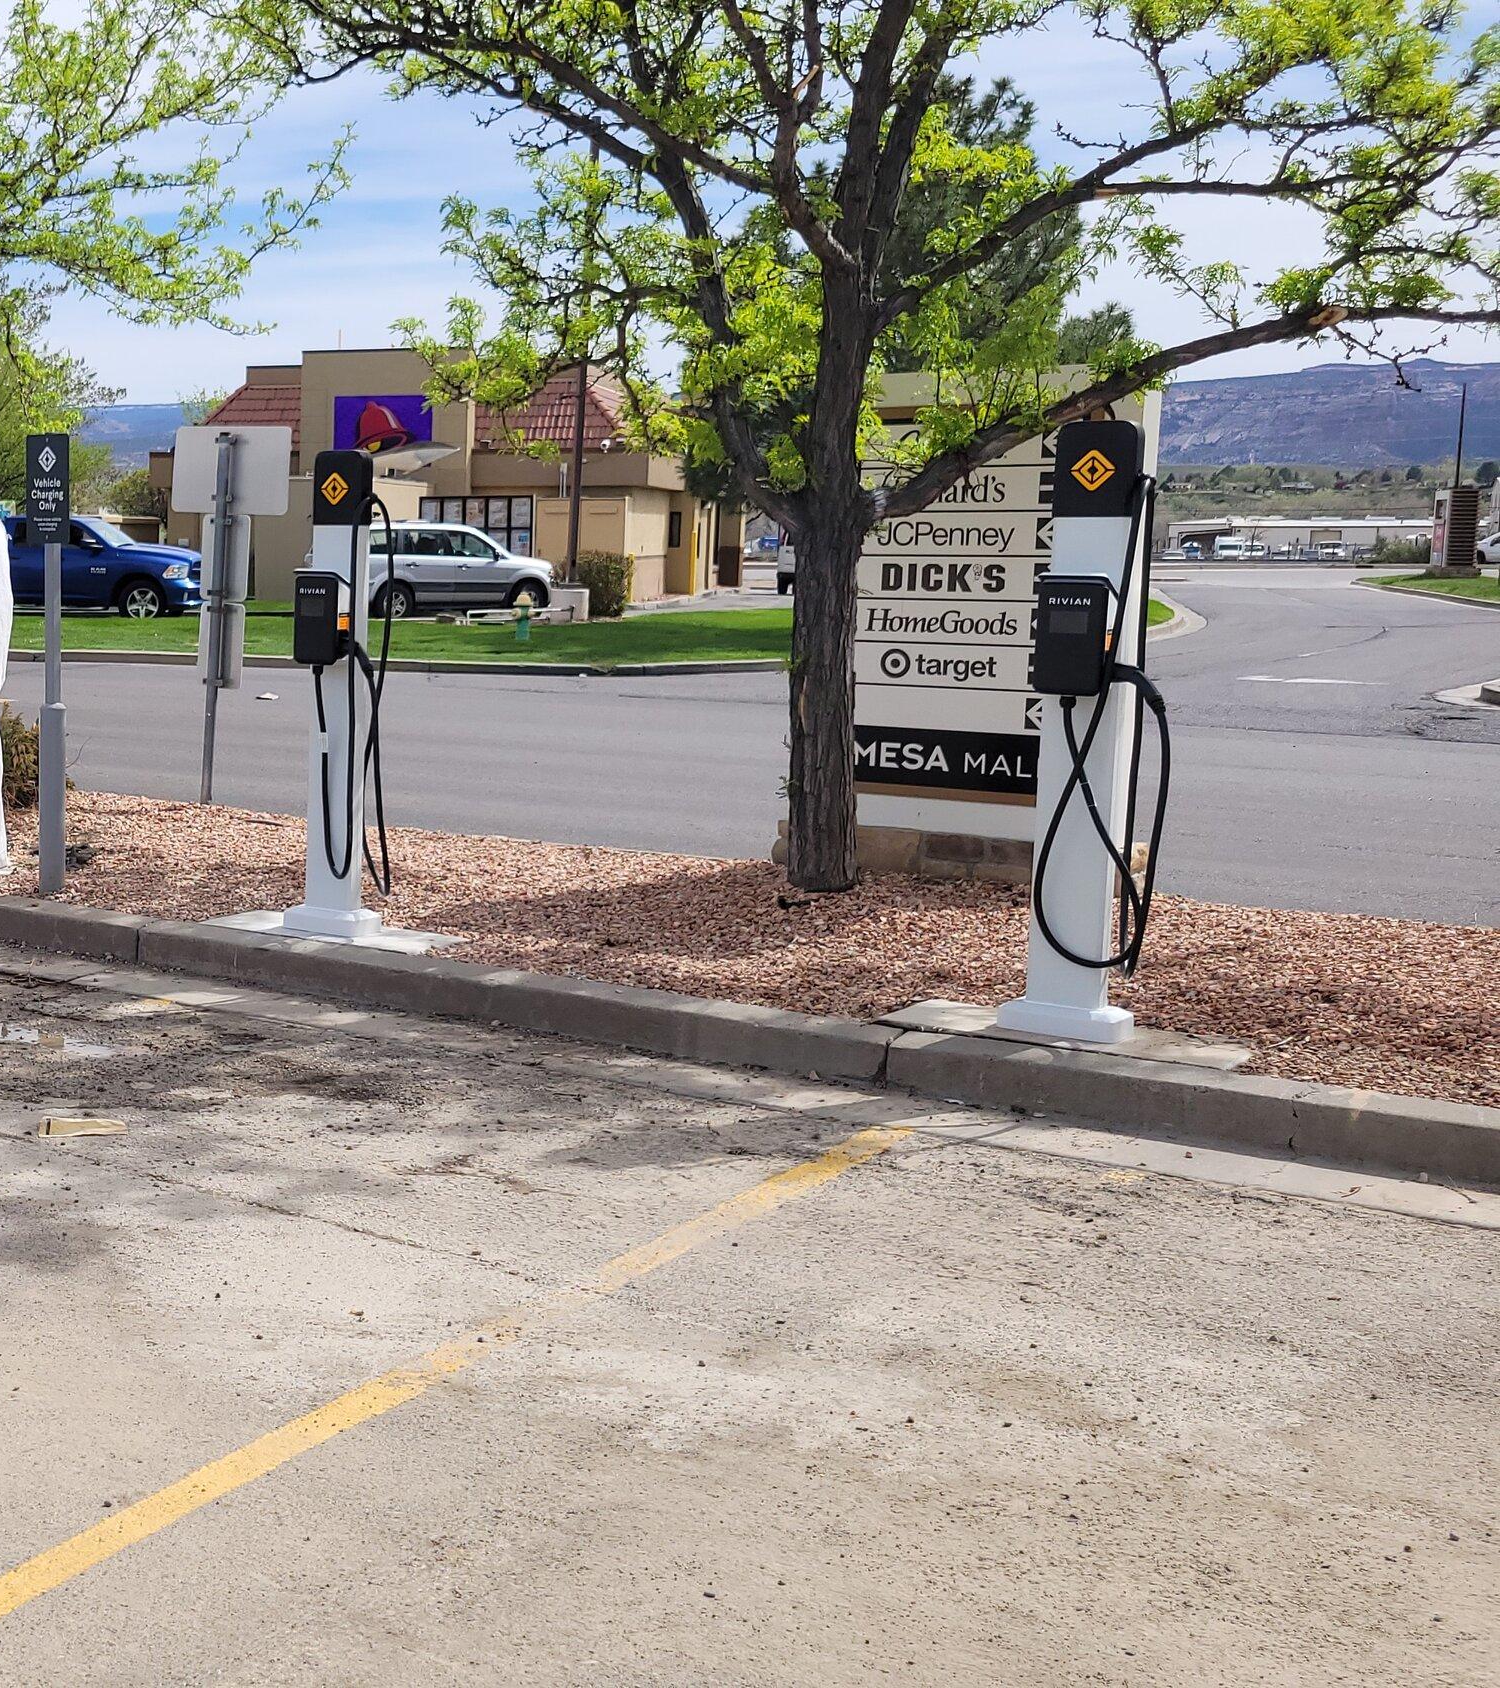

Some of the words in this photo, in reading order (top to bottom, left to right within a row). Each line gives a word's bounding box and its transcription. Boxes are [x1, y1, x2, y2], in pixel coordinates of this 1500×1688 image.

[31, 490, 64, 501] Charging
[33, 478, 61, 488] Vehicle
[38, 501, 56, 512] Only
[877, 521, 1015, 553] JCPenney
[881, 563, 1006, 593] DICK'S
[1048, 597, 1091, 606] RIVIAN
[864, 608, 1018, 636] HomeGoods
[915, 654, 998, 682] target
[854, 740, 950, 772] MESA
[963, 752, 1032, 778] MAL
